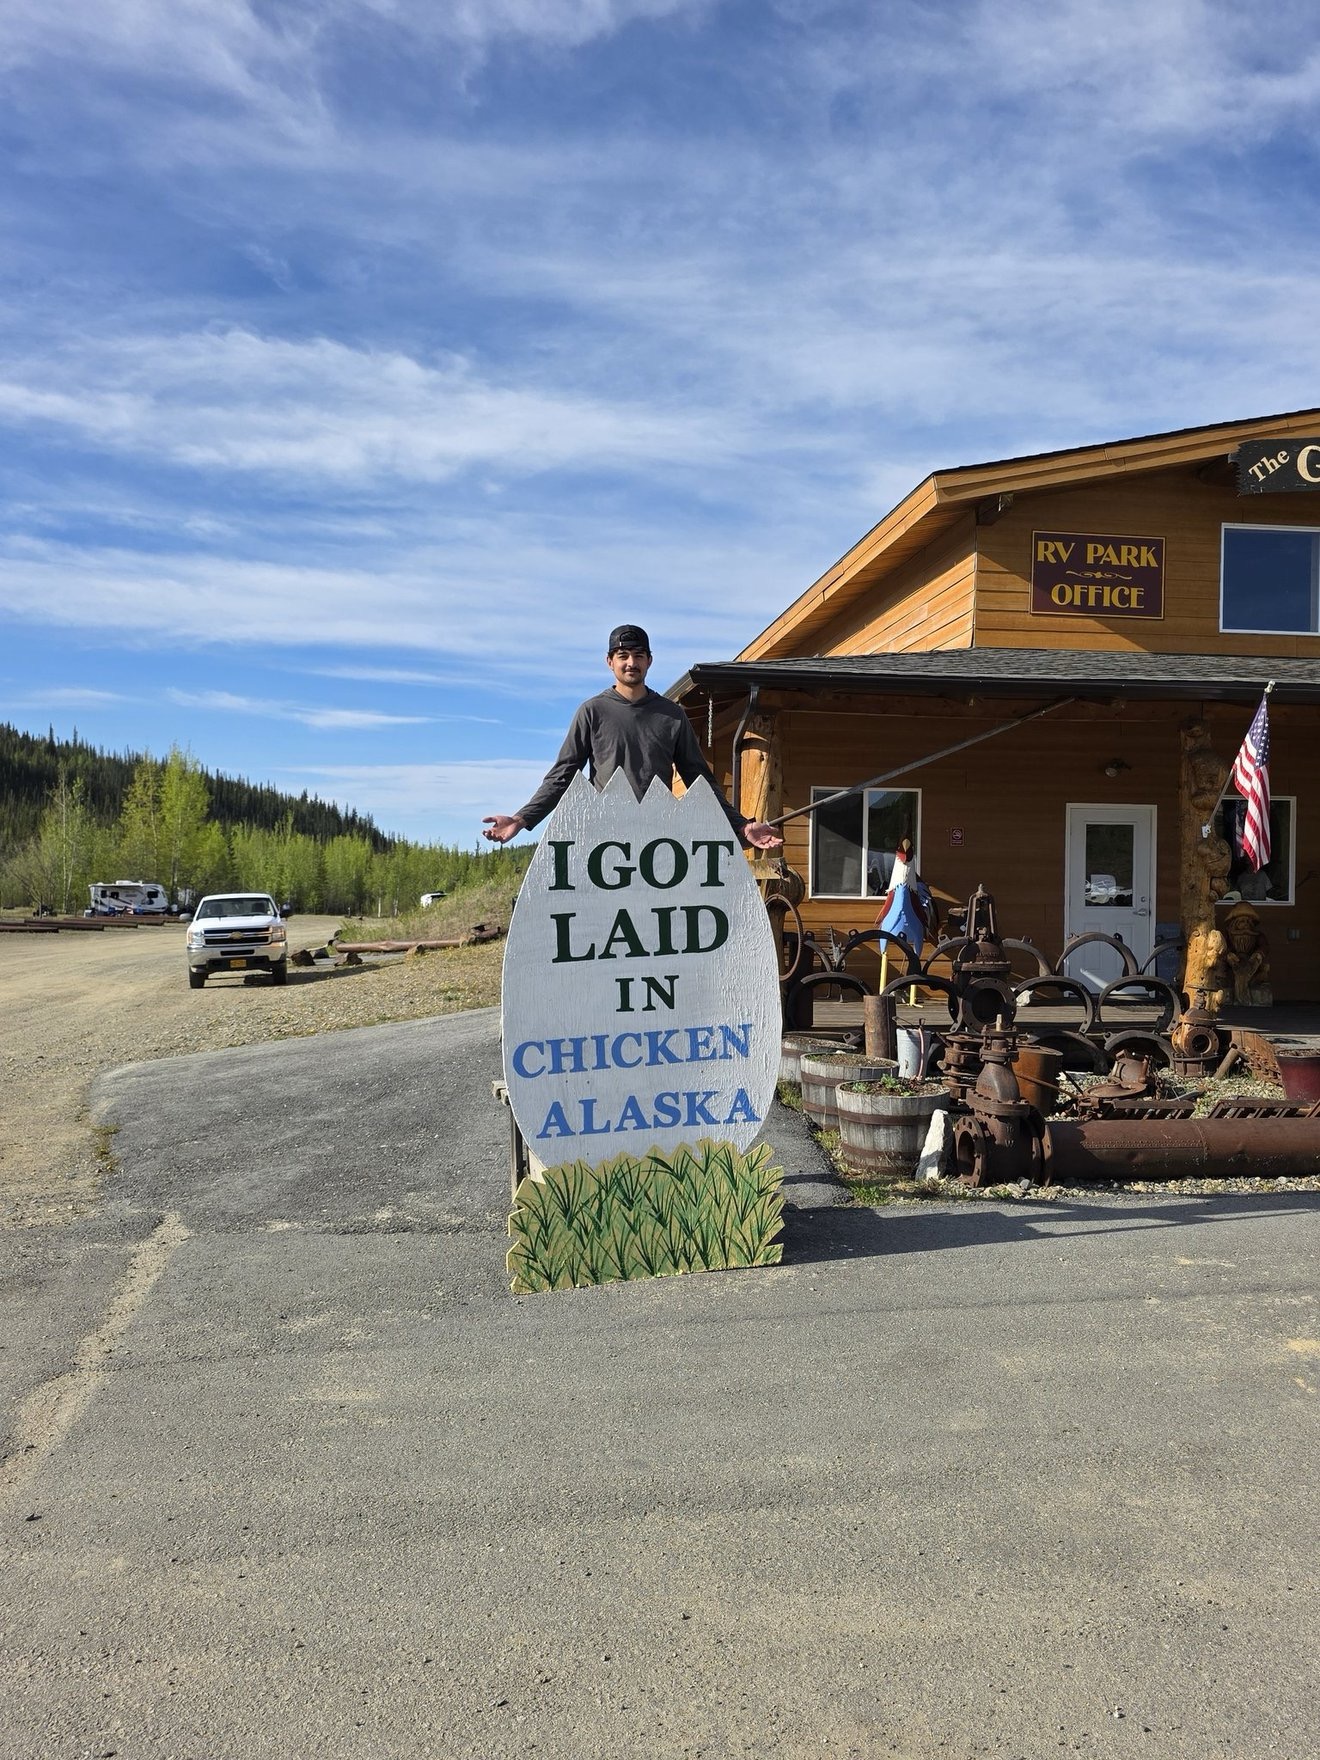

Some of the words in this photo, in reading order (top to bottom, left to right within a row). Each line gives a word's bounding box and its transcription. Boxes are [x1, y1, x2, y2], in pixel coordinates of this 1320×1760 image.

[1248, 450, 1290, 482] The
[1037, 541, 1075, 564] RV
[1086, 543, 1158, 568] PARK
[1051, 584, 1145, 609] OFFICE
[548, 840, 575, 891] I
[587, 838, 734, 890] GOT
[550, 905, 729, 963] LAID
[615, 975, 679, 1012] IN
[512, 1024, 753, 1079] CHICKEN
[536, 1087, 762, 1139] ALASKA
